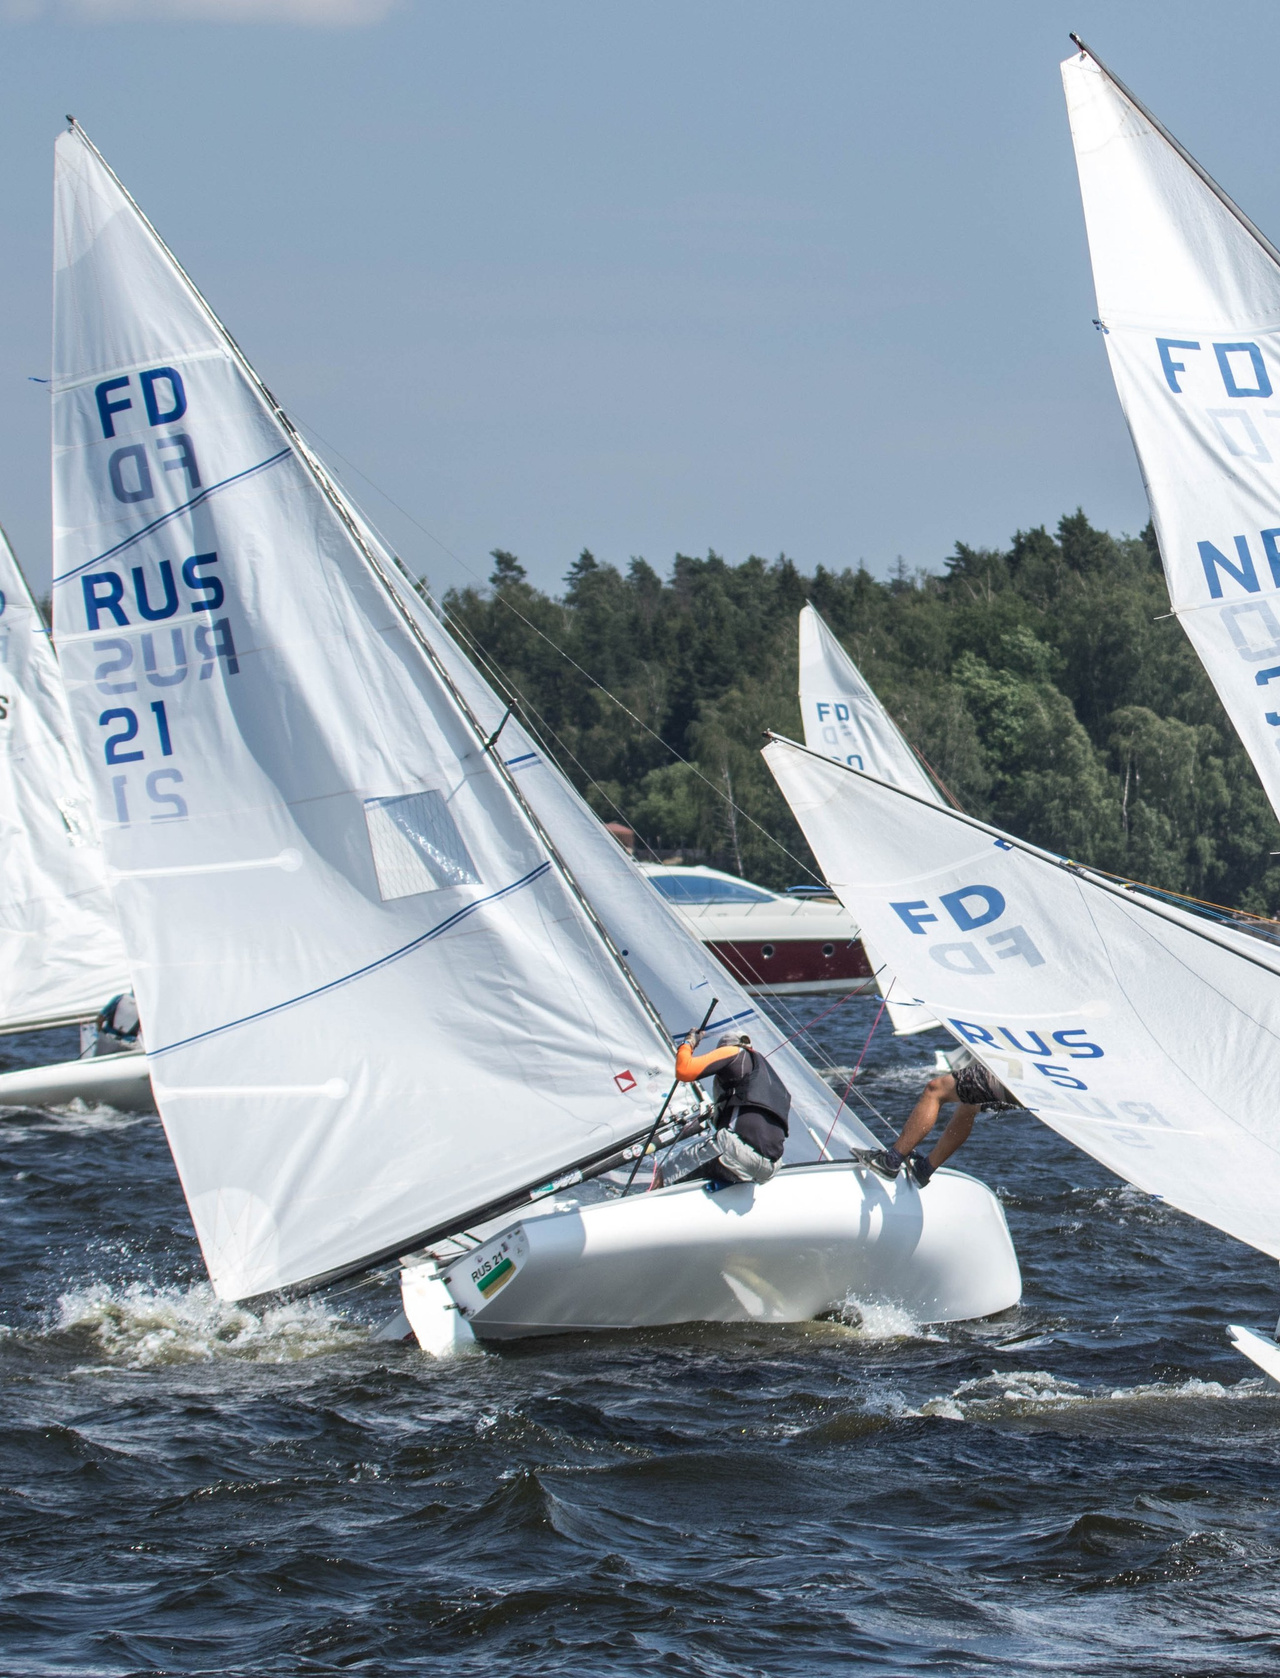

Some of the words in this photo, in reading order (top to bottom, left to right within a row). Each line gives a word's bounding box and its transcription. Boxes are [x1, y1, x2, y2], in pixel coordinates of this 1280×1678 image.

[1155, 337, 1273, 399] FD
[94, 366, 188, 439] FD
[80, 551, 224, 631] RUS
[99, 700, 173, 766] 21
[816, 702, 850, 722] FD
[889, 884, 1006, 935] FD
[947, 1017, 1105, 1059] RUS
[1033, 1062, 1088, 1091] 5
[471, 1261, 492, 1282] RUS
[492, 1251, 504, 1266] 21
